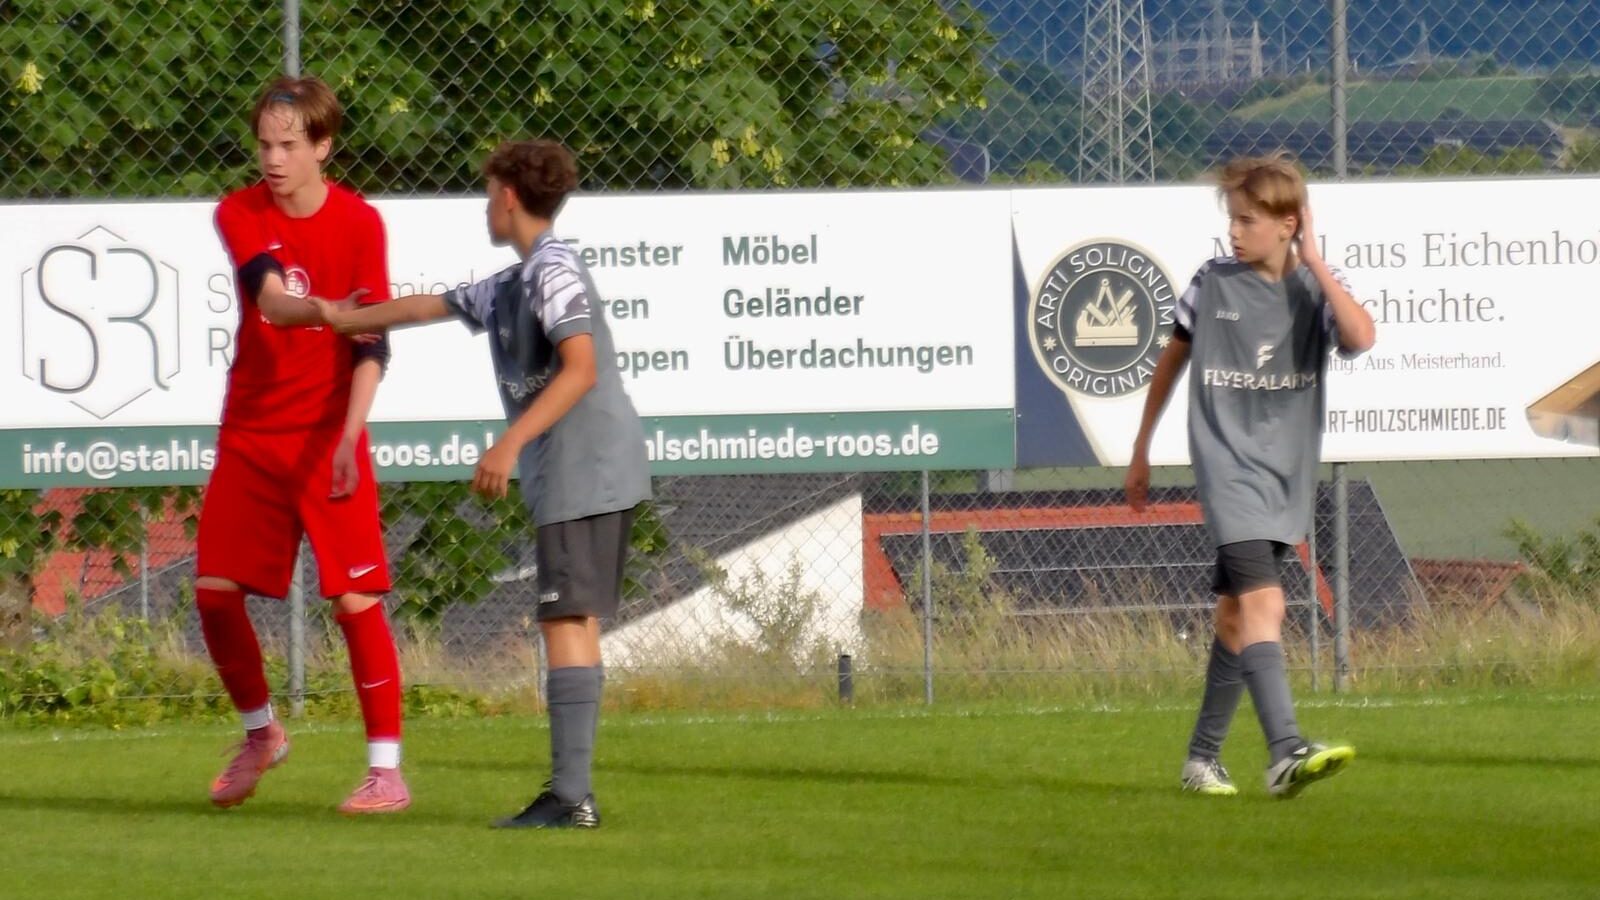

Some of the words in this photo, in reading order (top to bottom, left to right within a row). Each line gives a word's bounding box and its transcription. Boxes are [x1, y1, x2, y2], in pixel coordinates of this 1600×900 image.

[562, 237, 682, 267] enster
[722, 234, 818, 266] Möbel
[1344, 242, 1407, 269] aus
[1423, 229, 1600, 267] Eichenho
[723, 287, 866, 318] Geländer
[1037, 270, 1070, 330] ARTI
[1070, 247, 1176, 326] SOLIGNUM
[723, 335, 974, 373] Überdachungen
[1364, 355, 1395, 372] Aus
[1401, 352, 1506, 370] Meisterhand.
[1327, 408, 1507, 433] RT-HOLZSCHMIEDE.DE
[23, 440, 216, 479] info@stahls
